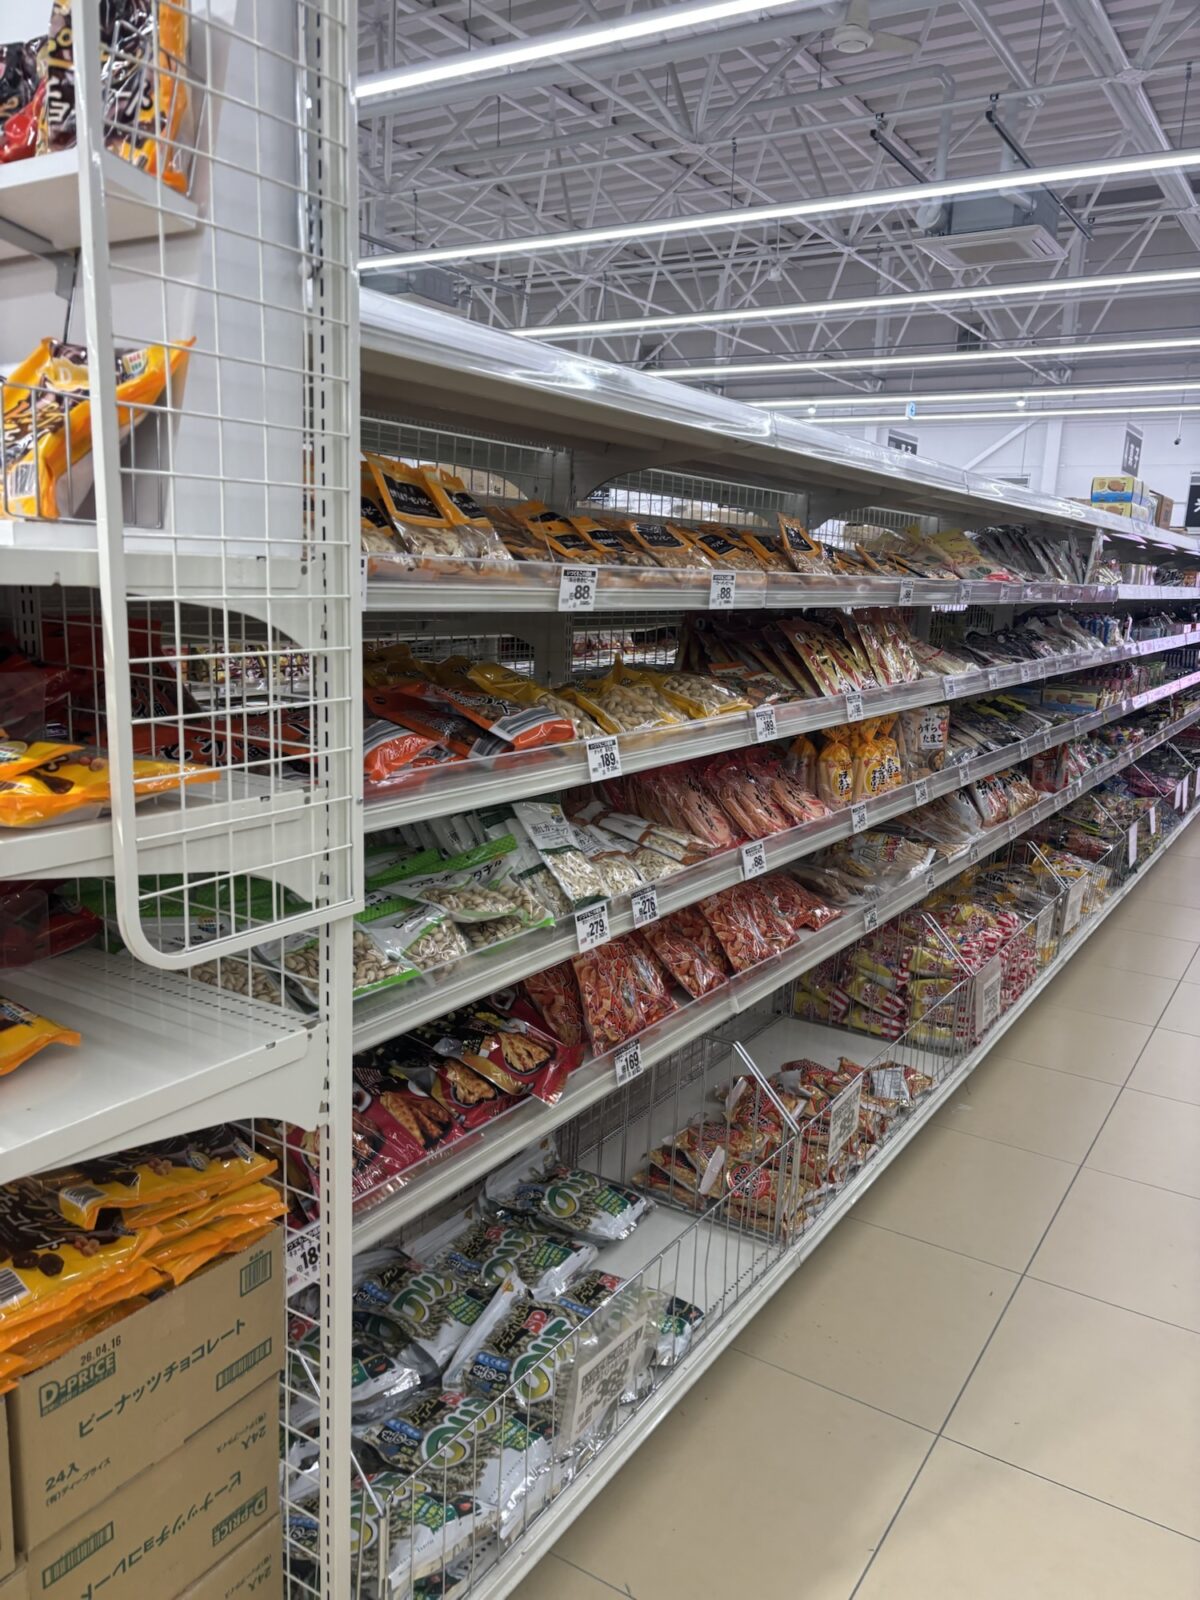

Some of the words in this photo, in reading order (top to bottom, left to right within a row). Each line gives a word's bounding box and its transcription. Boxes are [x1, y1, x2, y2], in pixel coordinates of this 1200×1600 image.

[574, 585, 590, 600] 88
[720, 587, 731, 599] 88
[601, 752, 616, 768] 189
[754, 855, 763, 867] 88
[589, 919, 605, 936] 279
[624, 1051, 639, 1071] 169
[300, 1242, 321, 1269] 18
[39, 1351, 116, 1416] D-PRICE
[78, 1319, 246, 1438] ピーナッツチョコレート
[241, 1425, 267, 1450] 24入
[45, 1462, 80, 1492] 24入
[212, 1487, 268, 1547] D-PRICE
[80, 1470, 242, 1600] ピーナッツチョコレート
